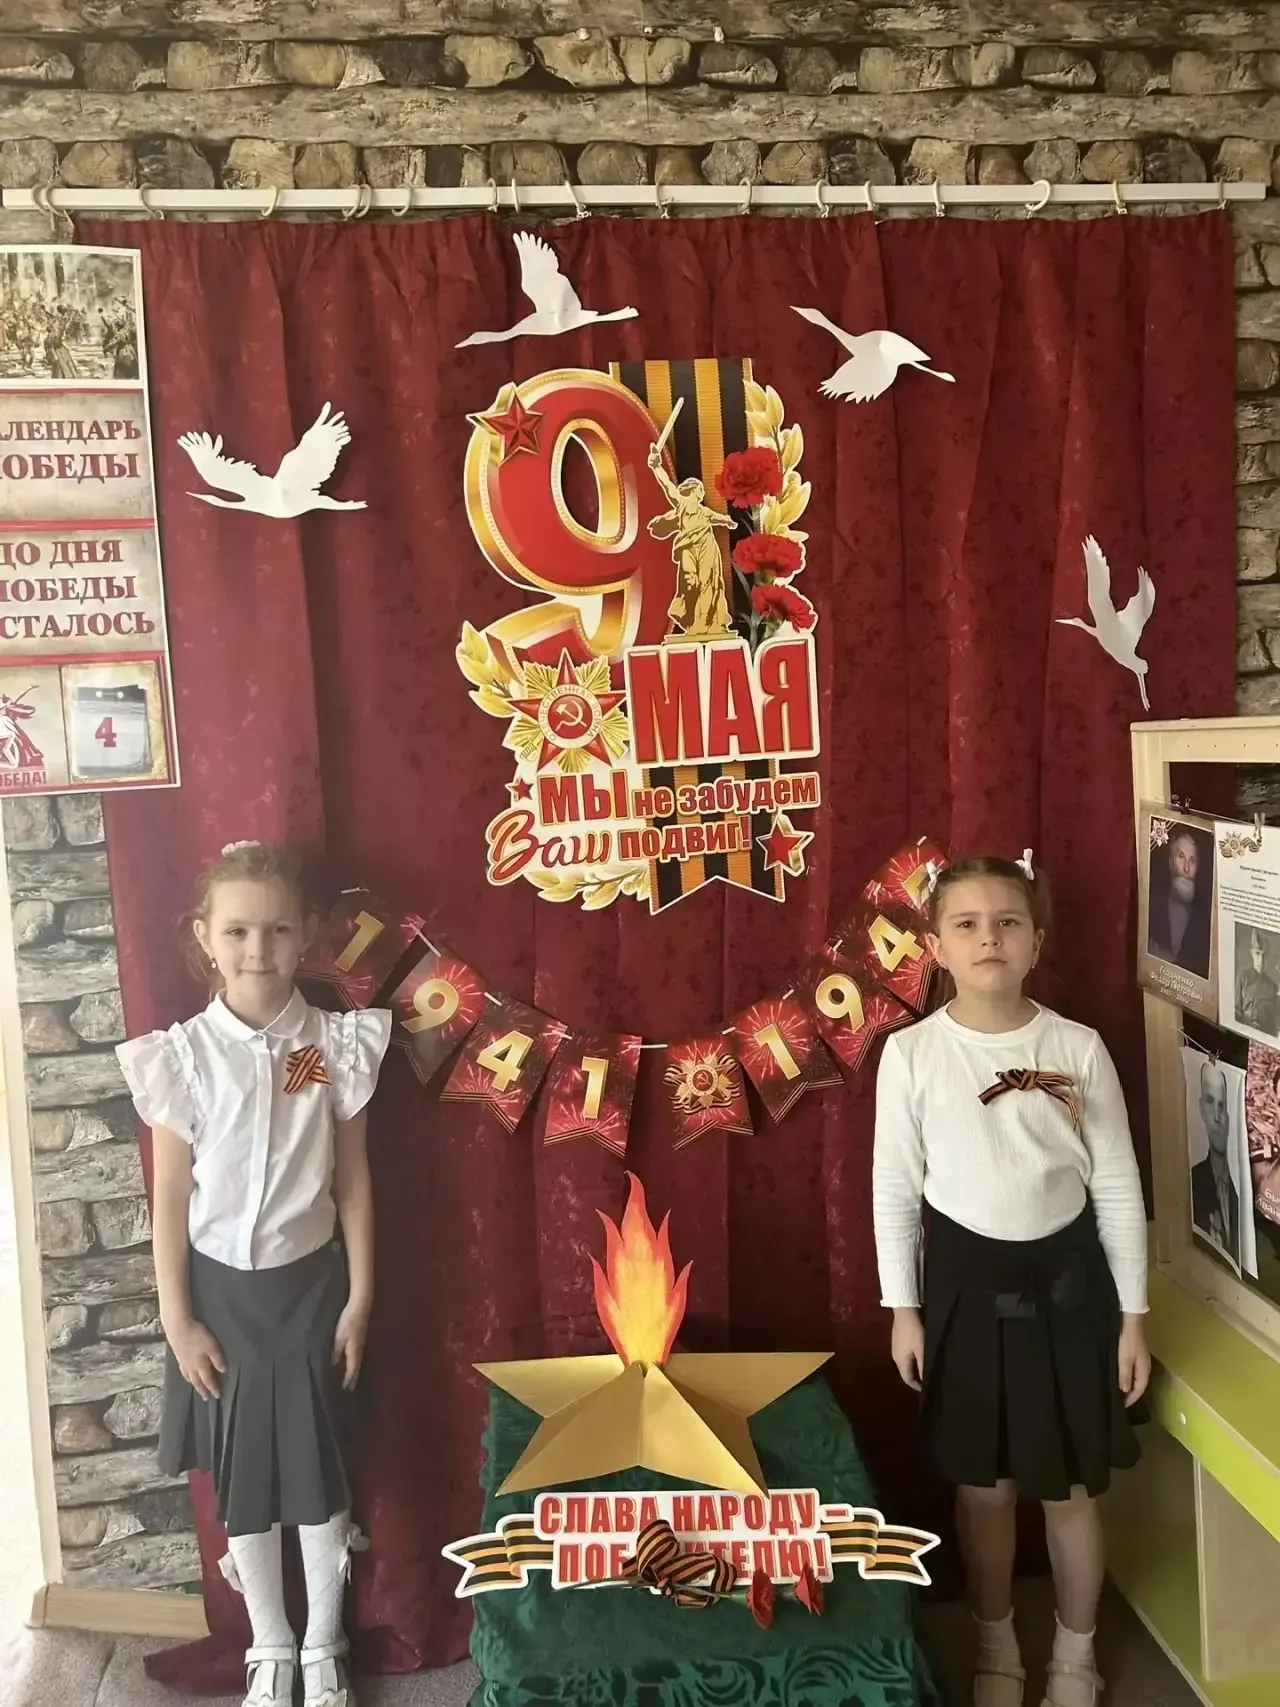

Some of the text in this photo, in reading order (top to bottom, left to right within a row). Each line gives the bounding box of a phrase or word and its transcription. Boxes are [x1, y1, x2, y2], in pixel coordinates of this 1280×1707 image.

[0, 419, 142, 444] ЛЕНДАРЬ
[0, 453, 140, 483] ОБЕДЫ
[49, 540, 123, 569] ДНЯ
[629, 640, 813, 764] МАЯ
[95, 717, 118, 748] 4
[0, 771, 47, 787] БЕДА!
[635, 788, 672, 816] не
[680, 777, 816, 812] забудем
[490, 810, 751, 880] Ваш подвиг!
[540, 1497, 660, 1534] СЛАВА
[673, 1493, 815, 1535] НАРОДУ
